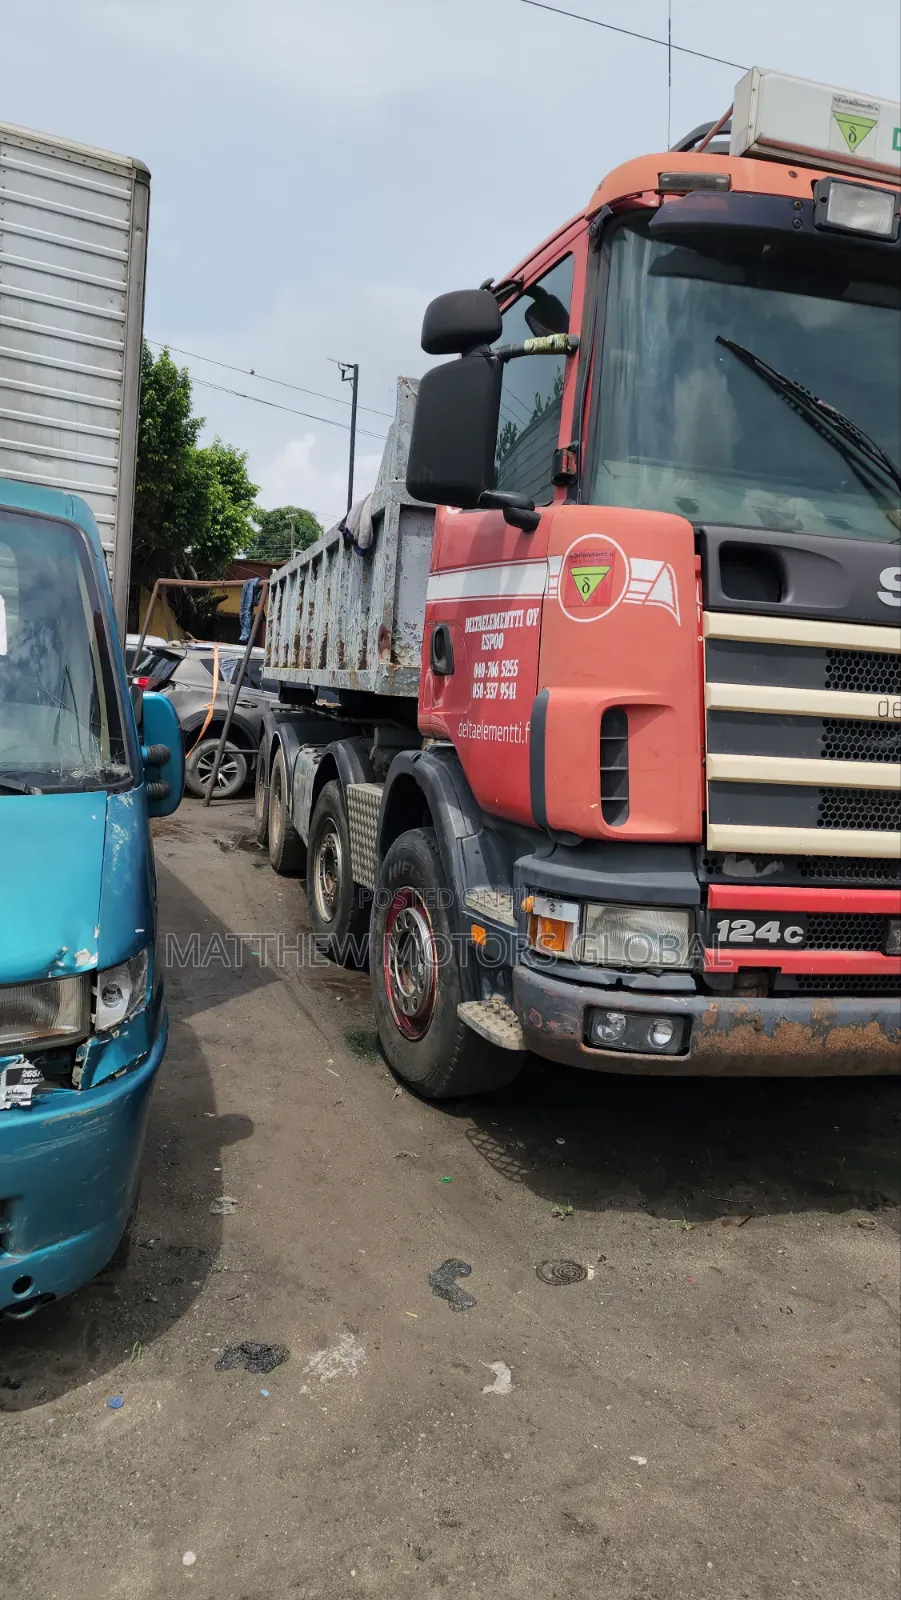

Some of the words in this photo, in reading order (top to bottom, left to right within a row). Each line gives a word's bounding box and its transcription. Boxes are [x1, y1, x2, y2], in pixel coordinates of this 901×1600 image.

[465, 609, 524, 633] DELTAELEMENTTI
[526, 607, 540, 627] OY
[481, 632, 504, 650] ESPOO
[501, 659, 519, 677] 5255
[472, 682, 499, 699] 050-337
[500, 682, 517, 699] 9541
